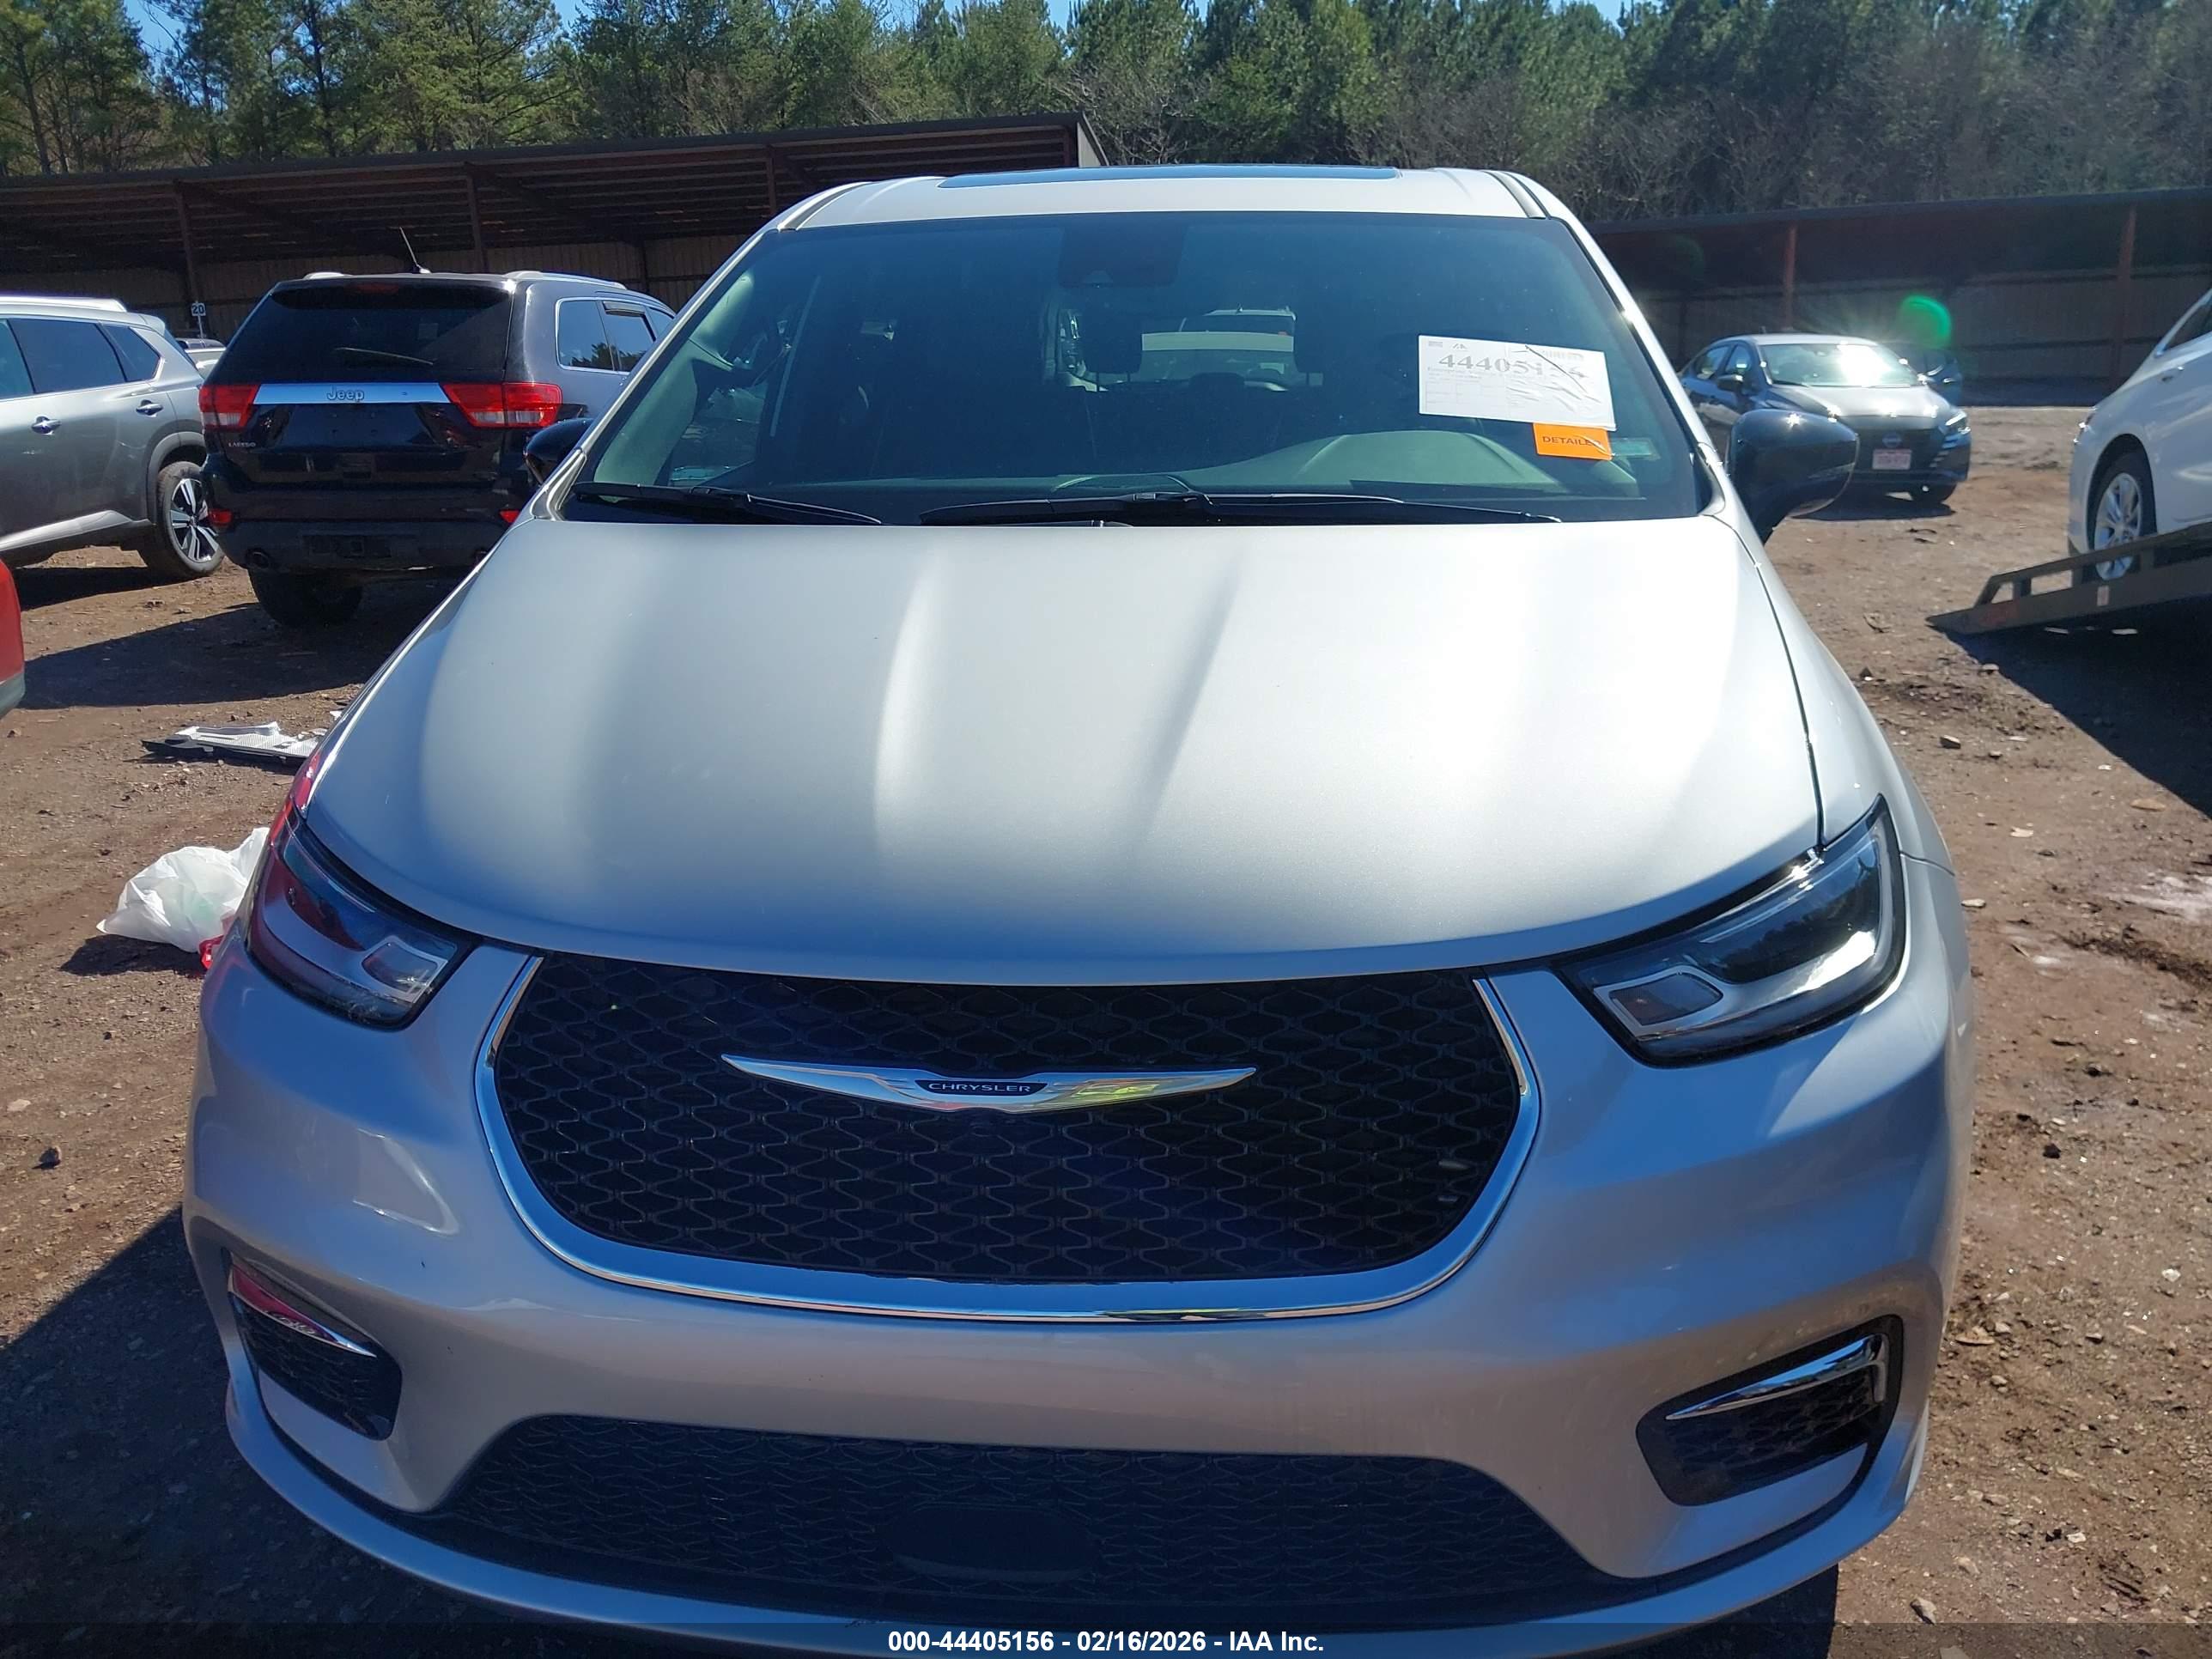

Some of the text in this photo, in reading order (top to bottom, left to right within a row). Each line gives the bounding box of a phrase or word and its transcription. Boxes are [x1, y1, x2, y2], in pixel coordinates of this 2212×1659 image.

[192, 305, 204, 314] 20
[326, 385, 365, 403] Jeep
[928, 1082, 1031, 1093] CHRYSLER
